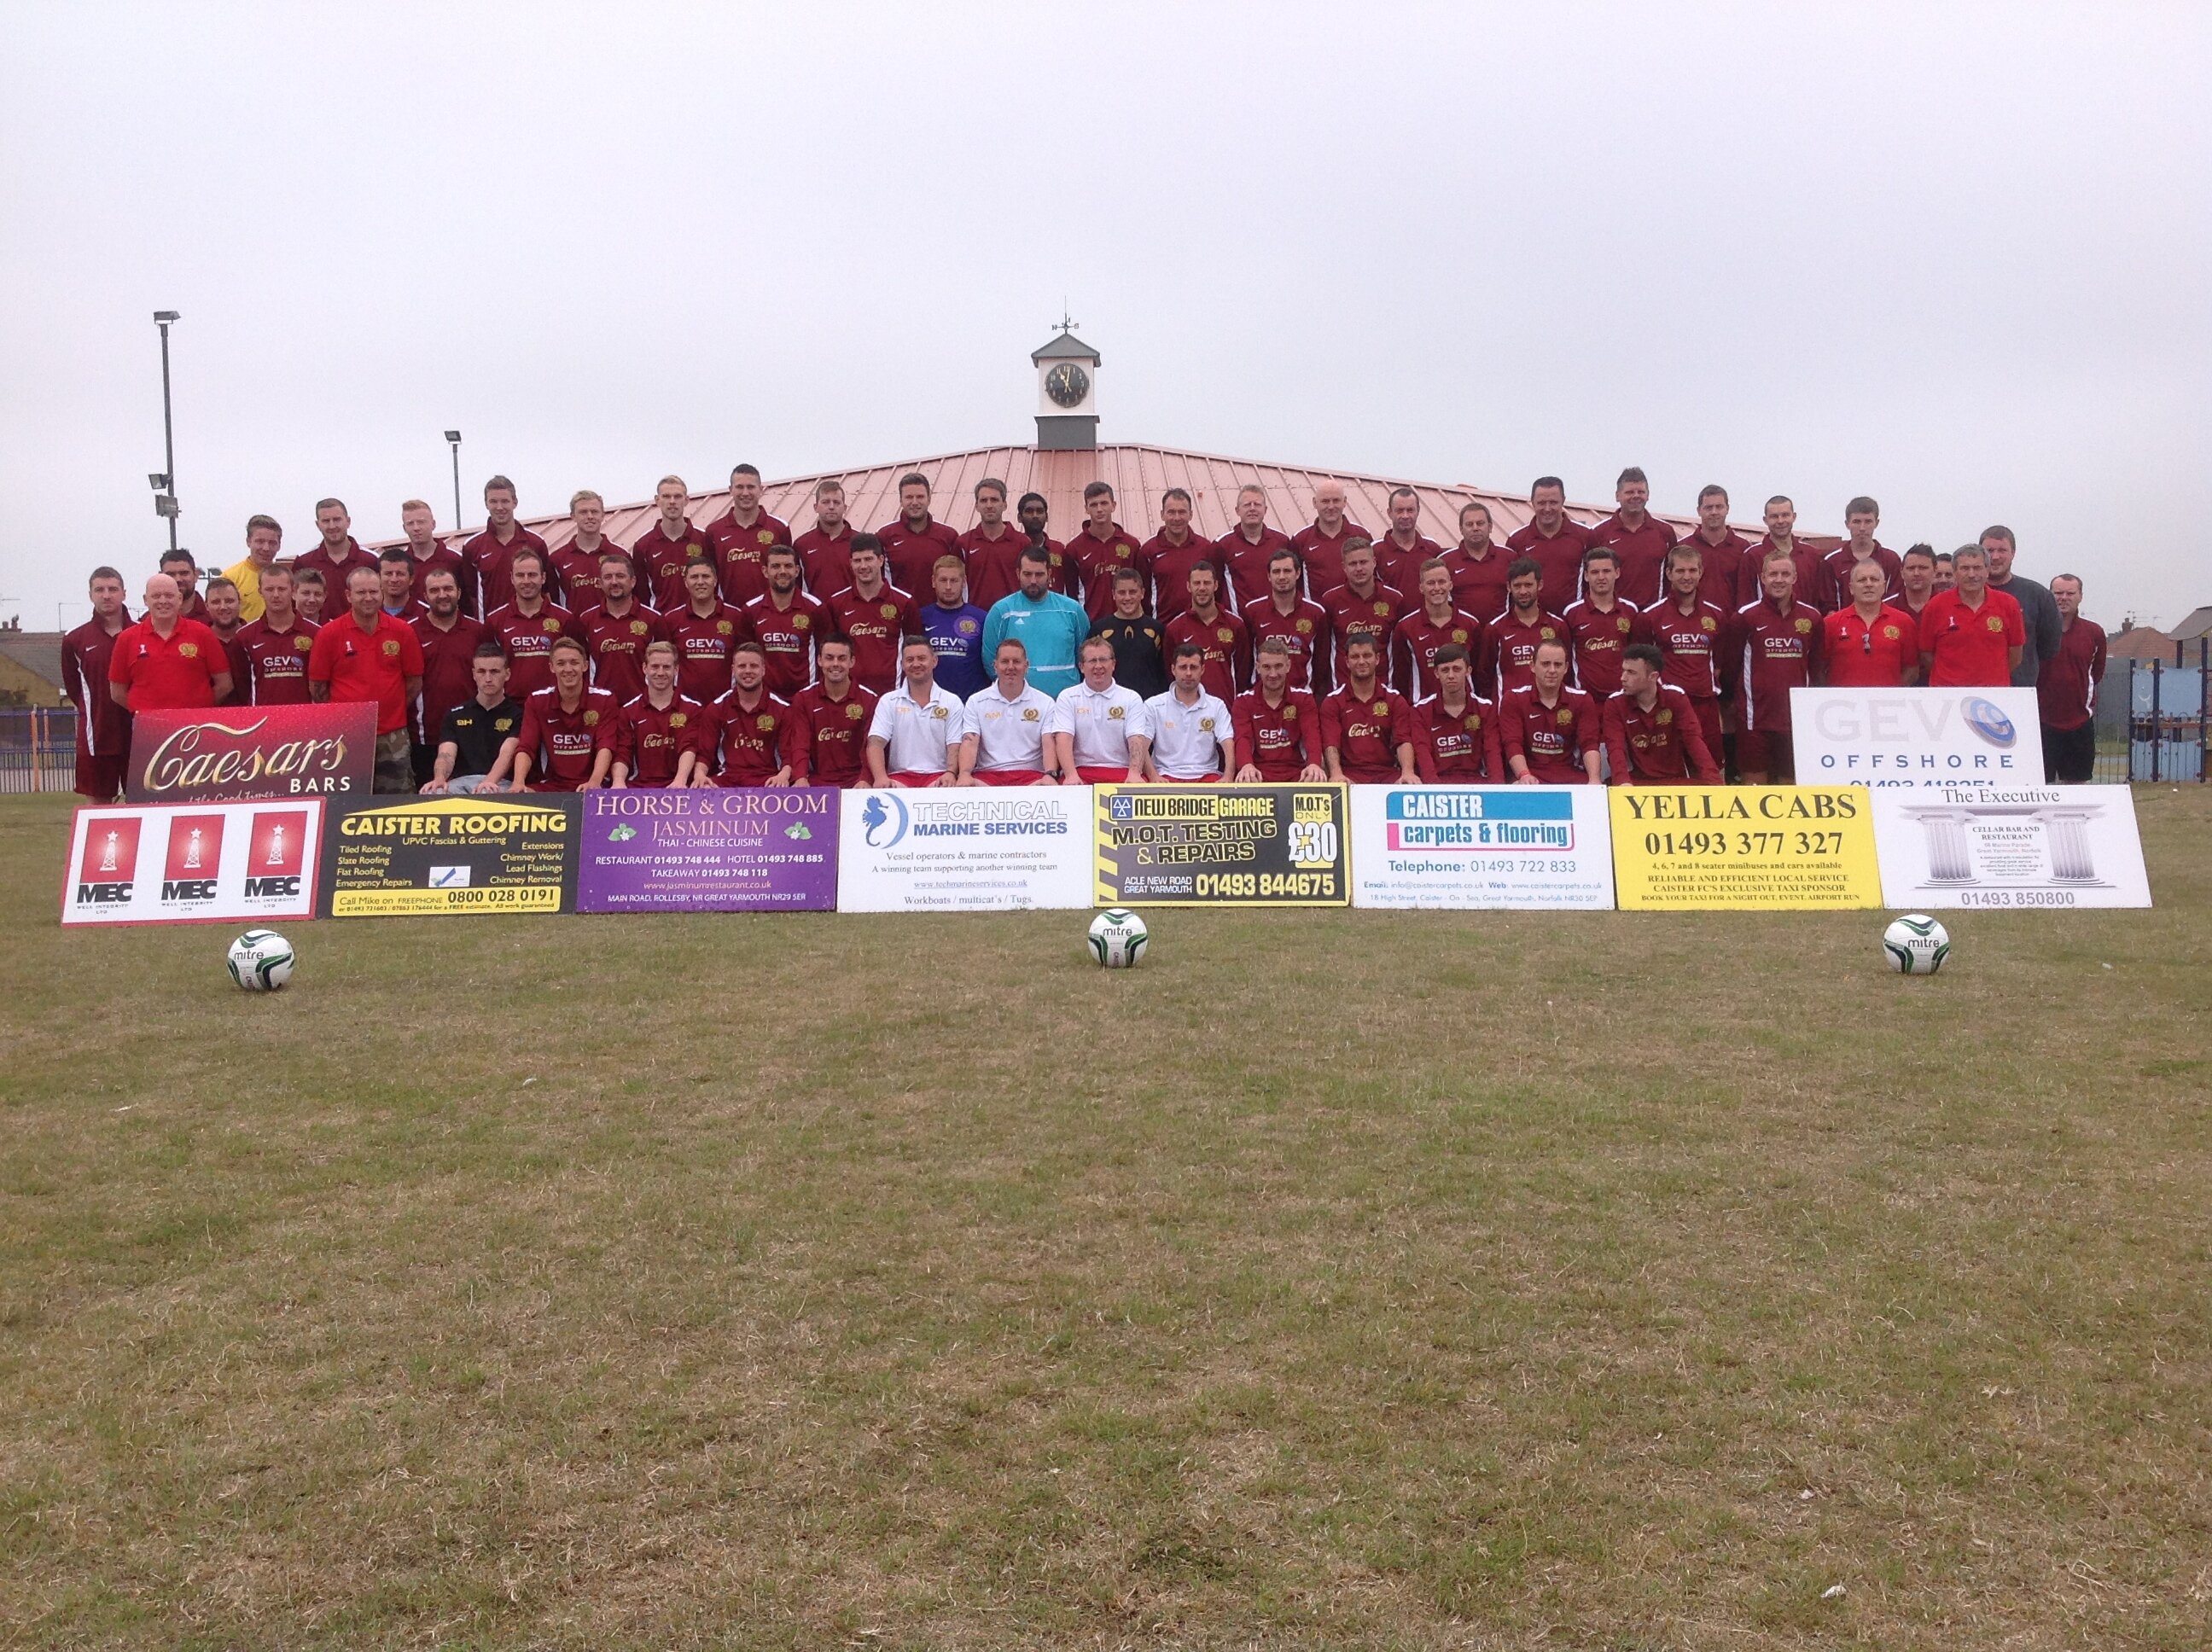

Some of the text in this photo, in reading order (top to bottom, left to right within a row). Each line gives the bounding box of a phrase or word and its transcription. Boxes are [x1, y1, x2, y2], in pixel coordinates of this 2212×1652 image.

[511, 636, 540, 646] GEV
[763, 632, 790, 642] GEV
[929, 637, 959, 647] GEV
[1671, 634, 1701, 643] GEV
[1764, 637, 1793, 647] GEV
[686, 639, 714, 648] GEV
[263, 656, 291, 666] GEV
[553, 734, 582, 744] GEV
[143, 716, 347, 791] Caesars
[1820, 754, 2013, 768] OFFSHORE
[289, 777, 352, 794] BARS
[1942, 788, 2060, 803] The Executive
[596, 794, 827, 816] HORSE & GROOM
[1220, 797, 1274, 817] GARAGE
[1295, 797, 1330, 811] M.O.T's
[1403, 794, 1482, 817] CAISTER
[1625, 794, 1857, 819] YELLA CABS
[913, 800, 1067, 822] TECHNICAL
[341, 814, 567, 835] CAISTER ROOFING
[652, 820, 769, 841] JASMINUM
[913, 822, 1067, 836] MARINE SERVICES
[1112, 820, 1278, 845] M.O.T. TESTING
[1405, 823, 1567, 846] carpets & flooring
[727, 838, 763, 846] CUISINE
[1288, 822, 1337, 862] £30
[1645, 832, 1842, 855] 01493 377 327
[362, 846, 392, 854] Roofing
[1137, 841, 1256, 864] & REPAIRS
[359, 857, 390, 865] Roofing
[596, 856, 652, 864] RESTAURANT
[655, 856, 683, 864] 01493
[684, 855, 701, 864] 748
[703, 855, 720, 864] 444
[727, 855, 755, 864] HOTEL
[886, 852, 913, 860] Vessel
[917, 852, 956, 862] operators
[353, 868, 384, 876] Roofing
[527, 864, 562, 874] Flashings
[651, 869, 768, 877] TAKEAWAY 01493 748 118
[934, 864, 974, 874] supporting
[1006, 864, 1036, 872] winning
[1388, 860, 1576, 875] Telephone: 01493 722 833
[383, 879, 412, 887] Repairs
[490, 876, 526, 885] Chimney
[1125, 876, 1192, 885] ACLE NEW ROAD
[1196, 873, 1335, 896] 01493 844675
[77, 882, 133, 904] MEC
[161, 879, 218, 901] MEC
[244, 876, 300, 898] MEC
[1124, 885, 1149, 893] GREAT
[340, 897, 356, 905] Call
[448, 890, 484, 903] 0800
[488, 890, 515, 902] 028
[520, 889, 554, 901] 0191
[905, 896, 951, 905] Workboats
[1961, 892, 2075, 905] 01493 850800
[1103, 927, 1132, 937] mitre
[1907, 938, 1940, 948] mitre
[234, 949, 265, 961] mitre
